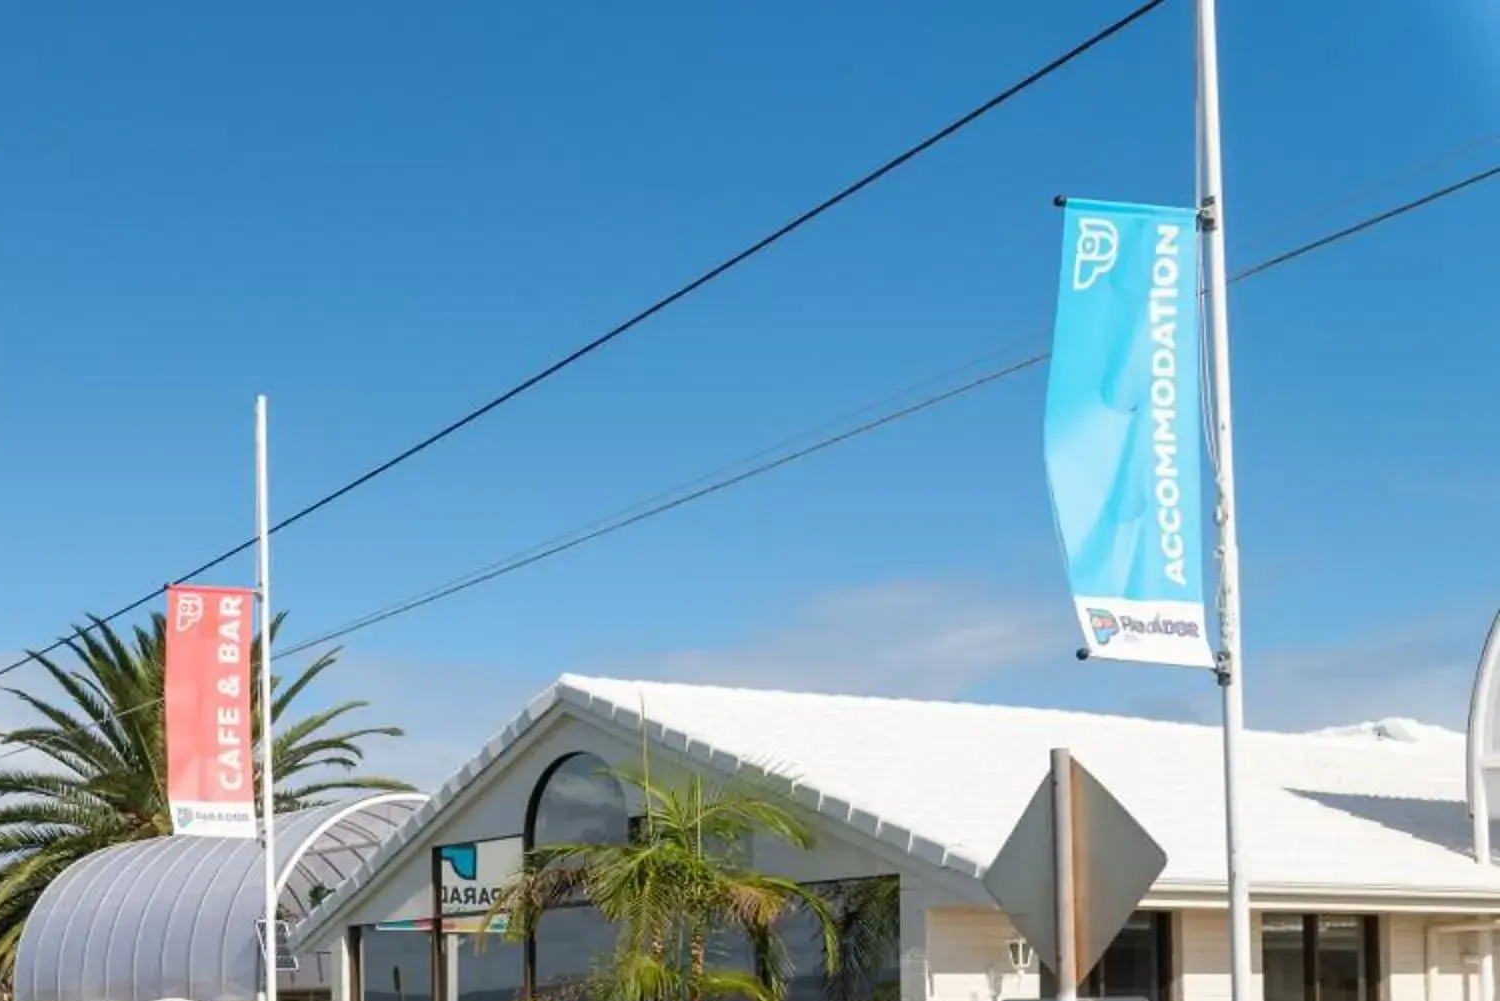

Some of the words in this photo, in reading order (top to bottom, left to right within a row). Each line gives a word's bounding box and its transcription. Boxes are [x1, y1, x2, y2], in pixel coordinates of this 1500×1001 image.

[1149, 224, 1187, 587] ACCOMMODATION
[217, 594, 243, 664] BAR
[216, 674, 241, 699] &
[217, 706, 243, 792] CAFE
